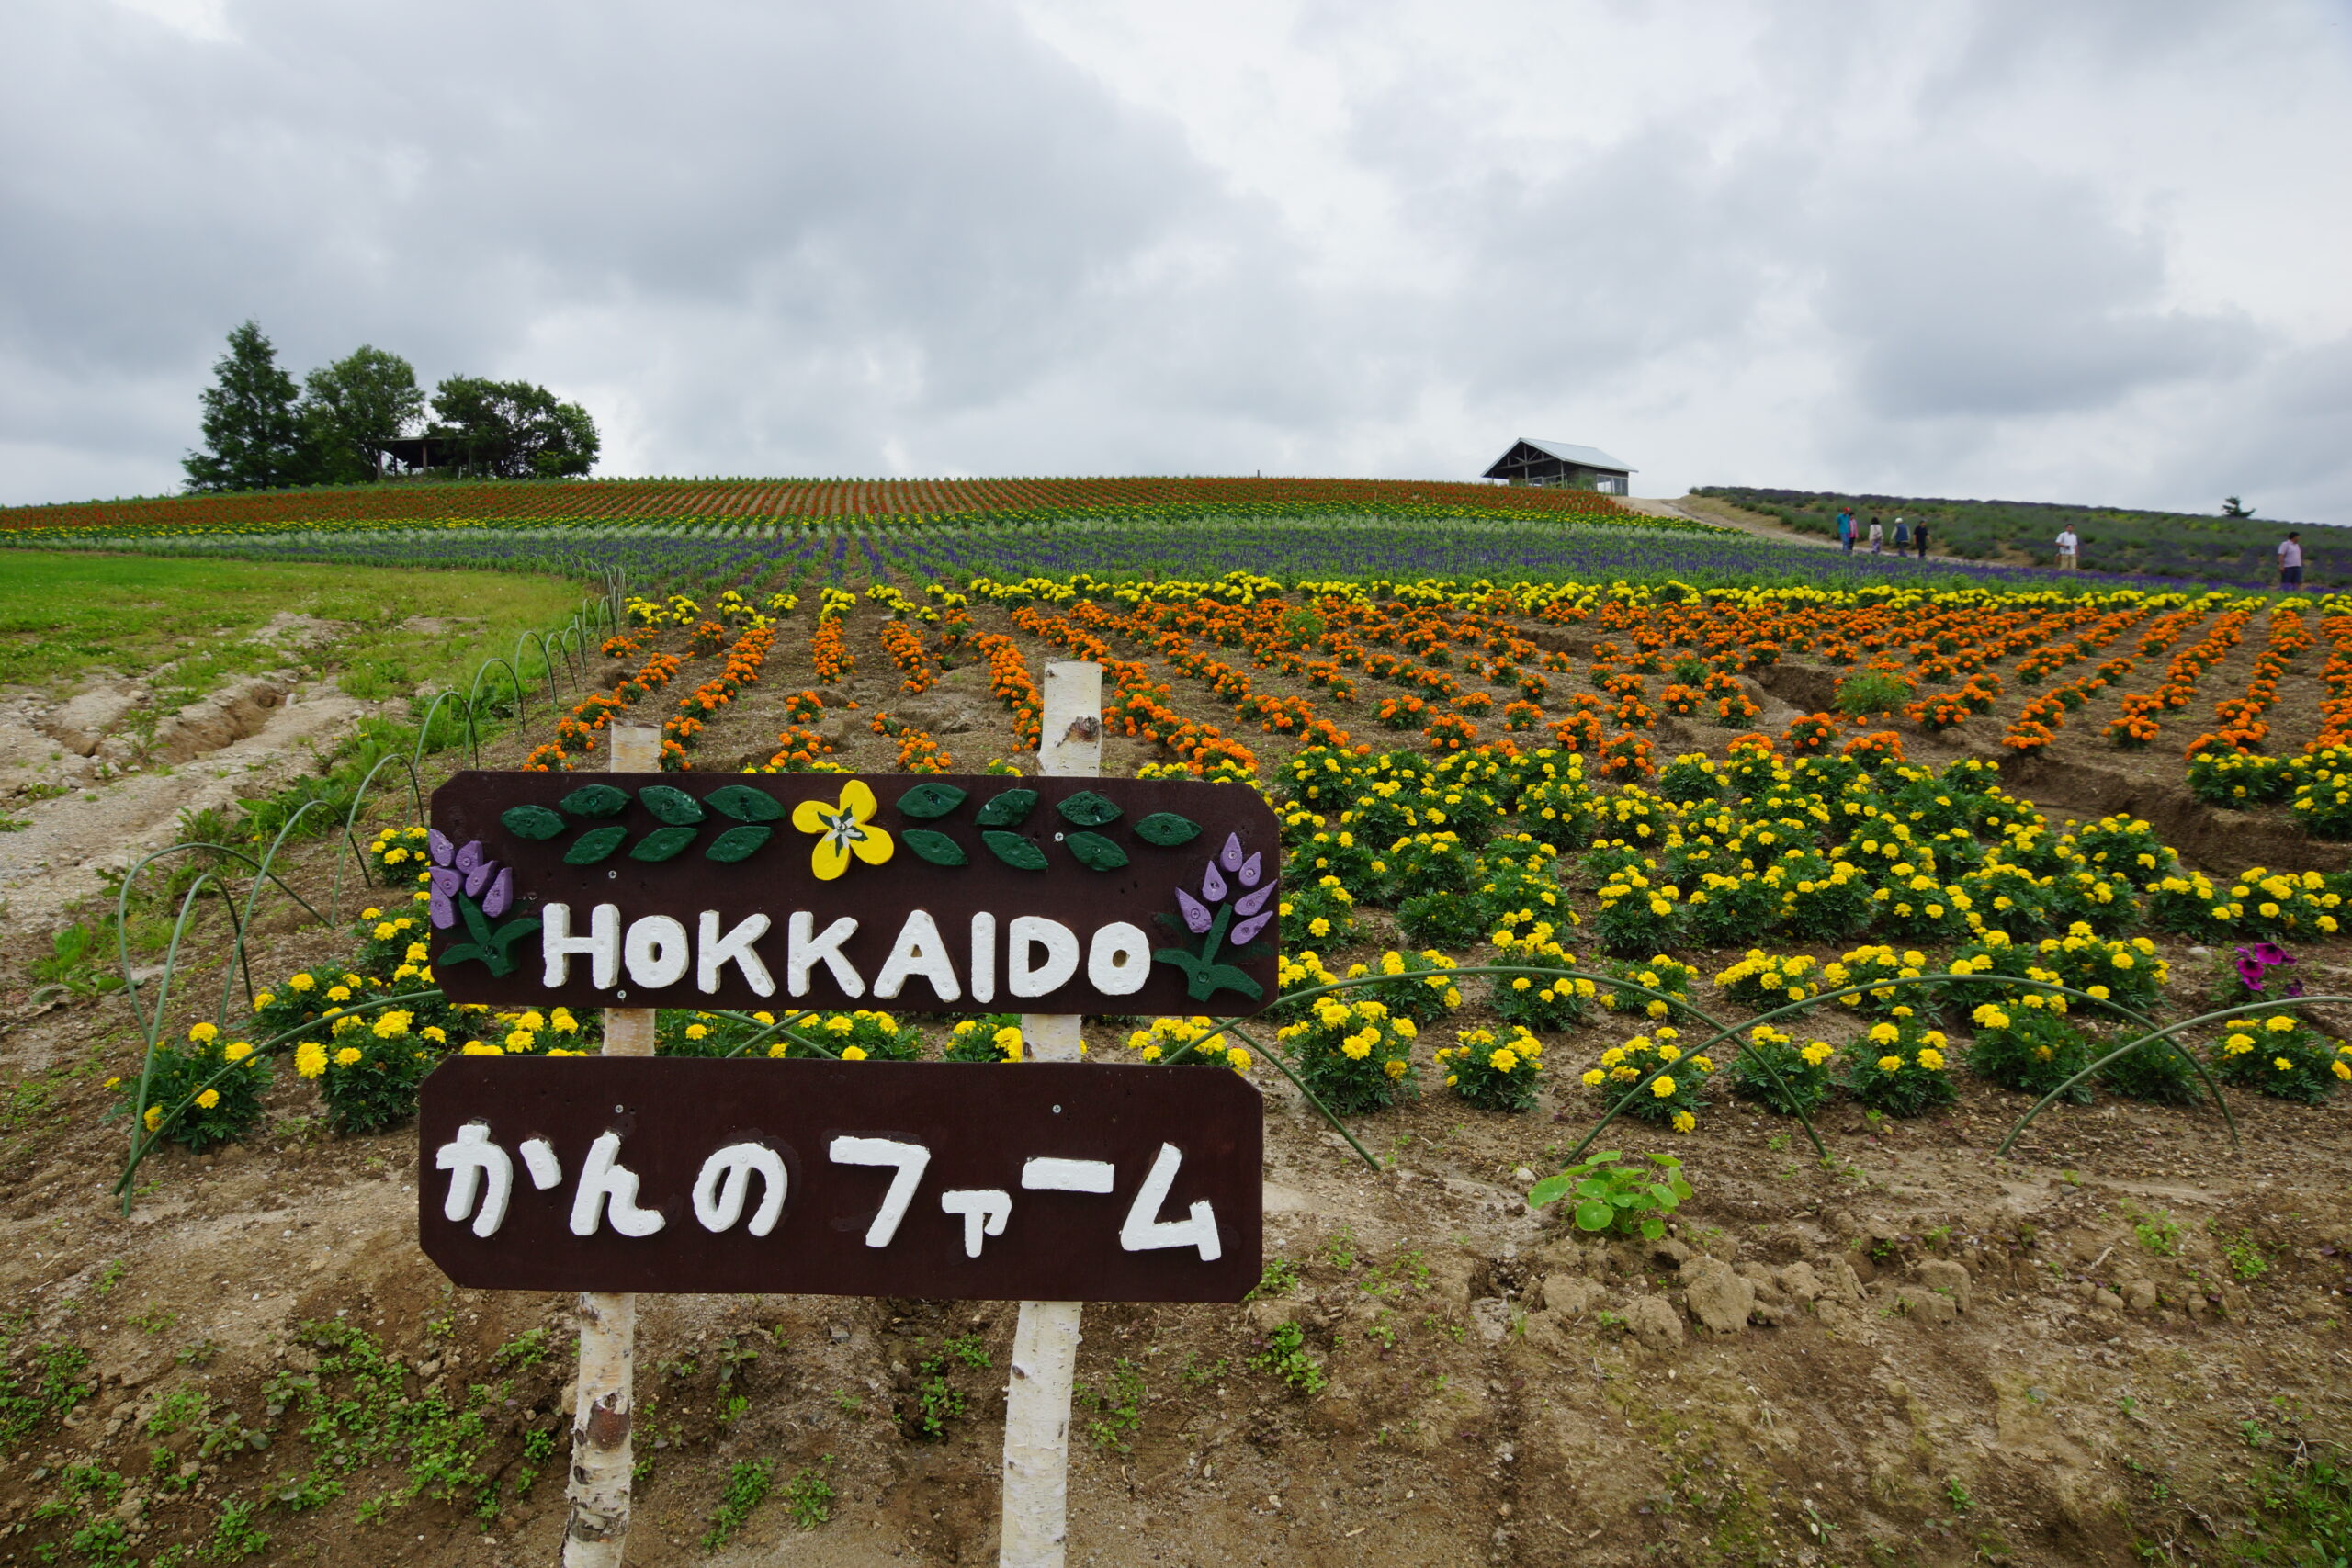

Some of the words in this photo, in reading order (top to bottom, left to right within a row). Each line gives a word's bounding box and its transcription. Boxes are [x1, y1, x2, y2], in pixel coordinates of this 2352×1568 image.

[542, 902, 1151, 1004] HOKKAIDO
[435, 1122, 1222, 1261] かんのファーム
